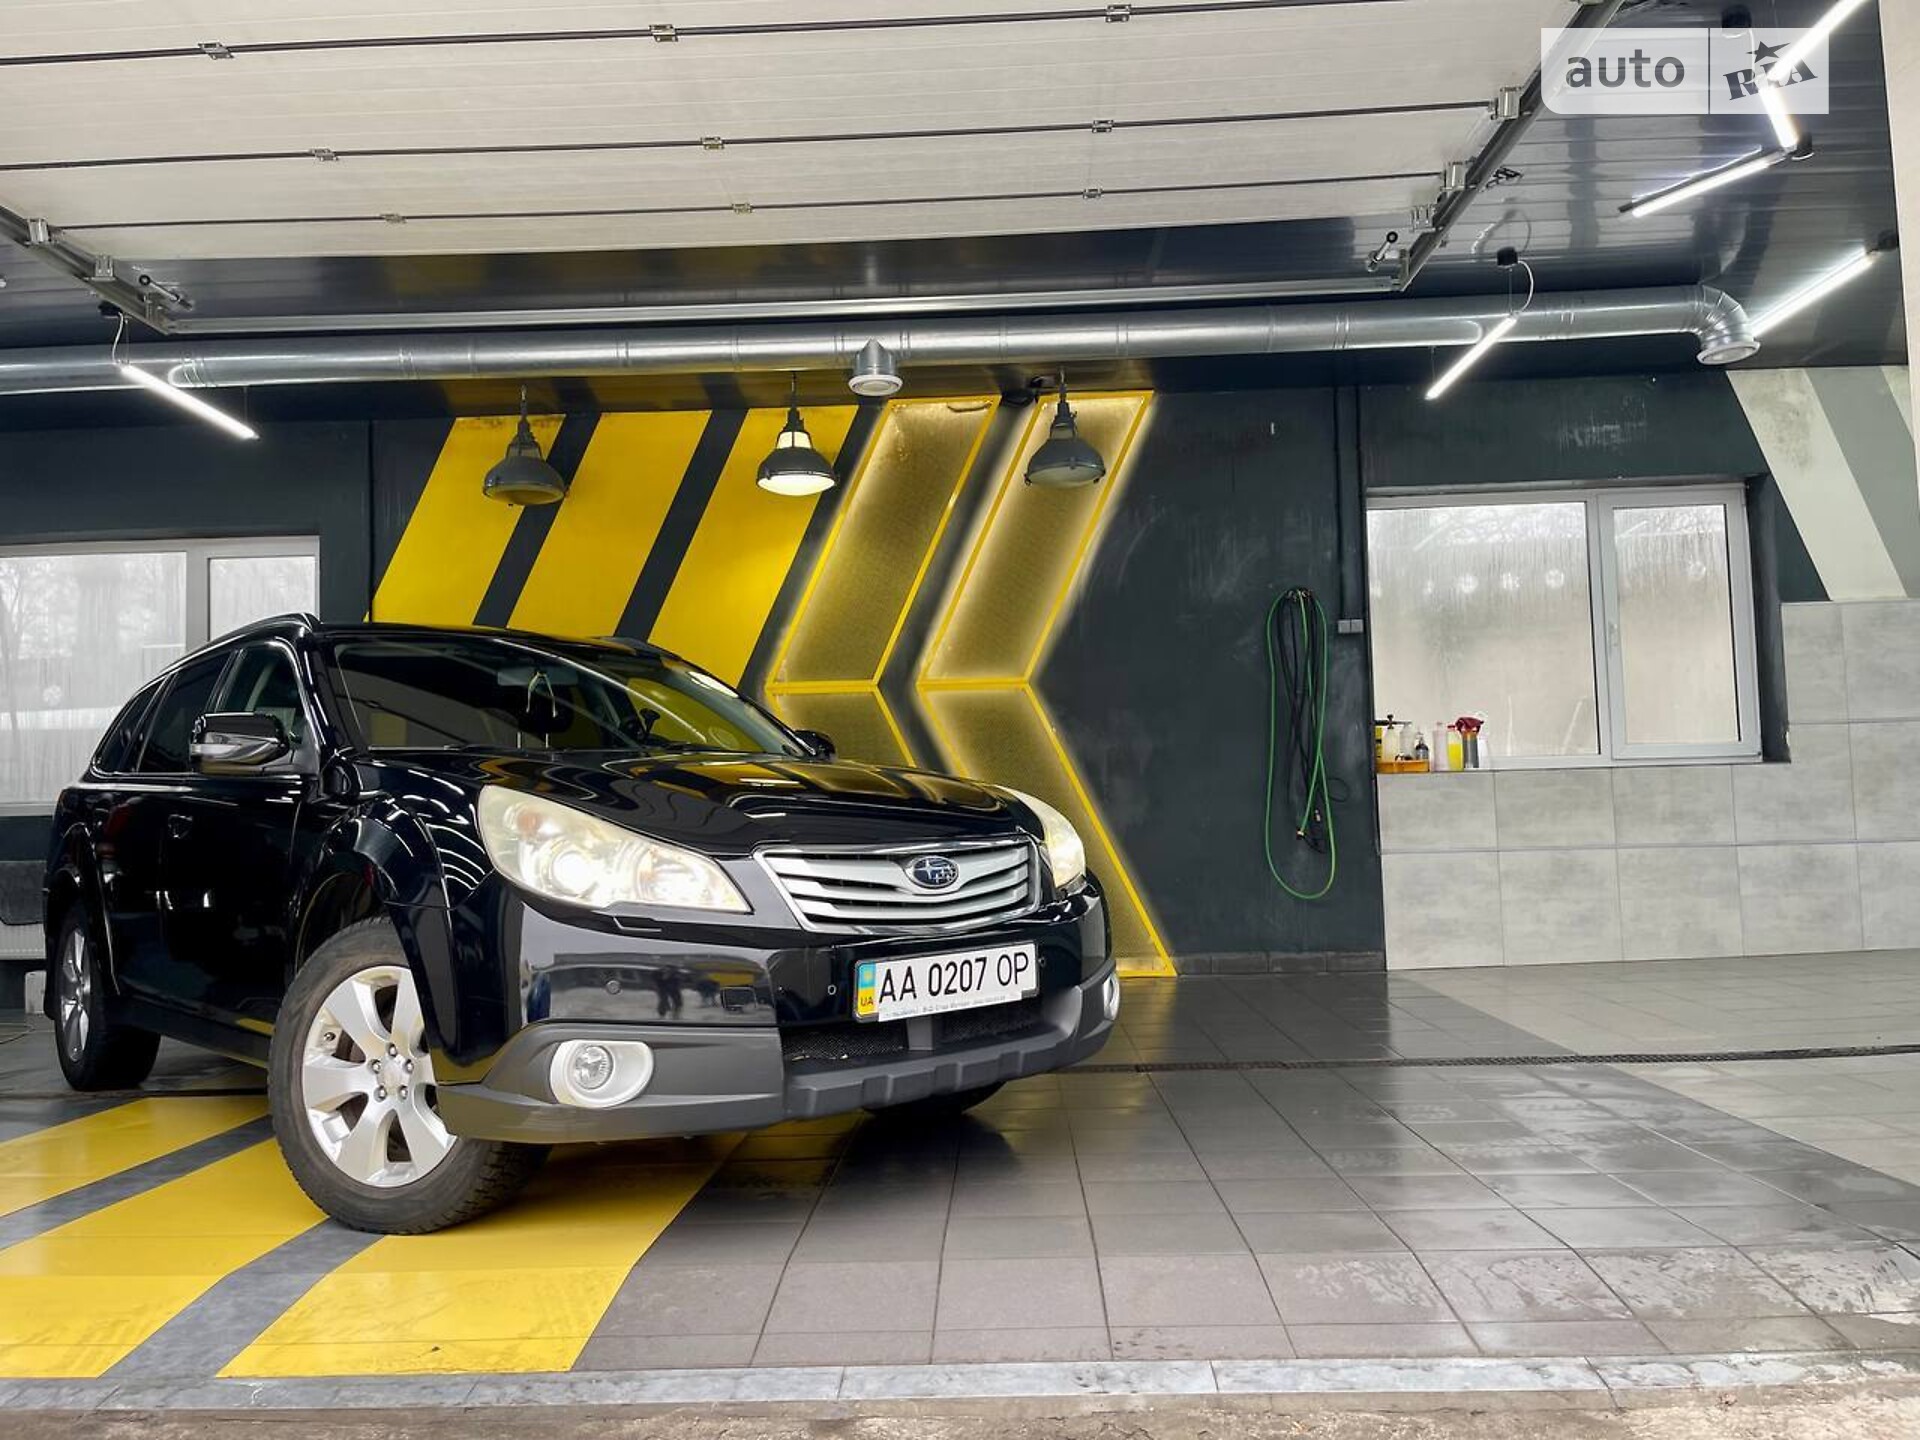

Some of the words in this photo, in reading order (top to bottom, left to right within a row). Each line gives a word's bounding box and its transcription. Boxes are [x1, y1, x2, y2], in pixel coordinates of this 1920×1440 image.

[879, 966, 917, 1003] AA
[928, 957, 987, 996] 0207
[997, 951, 1029, 986] OP
[860, 995, 874, 1007] UA
